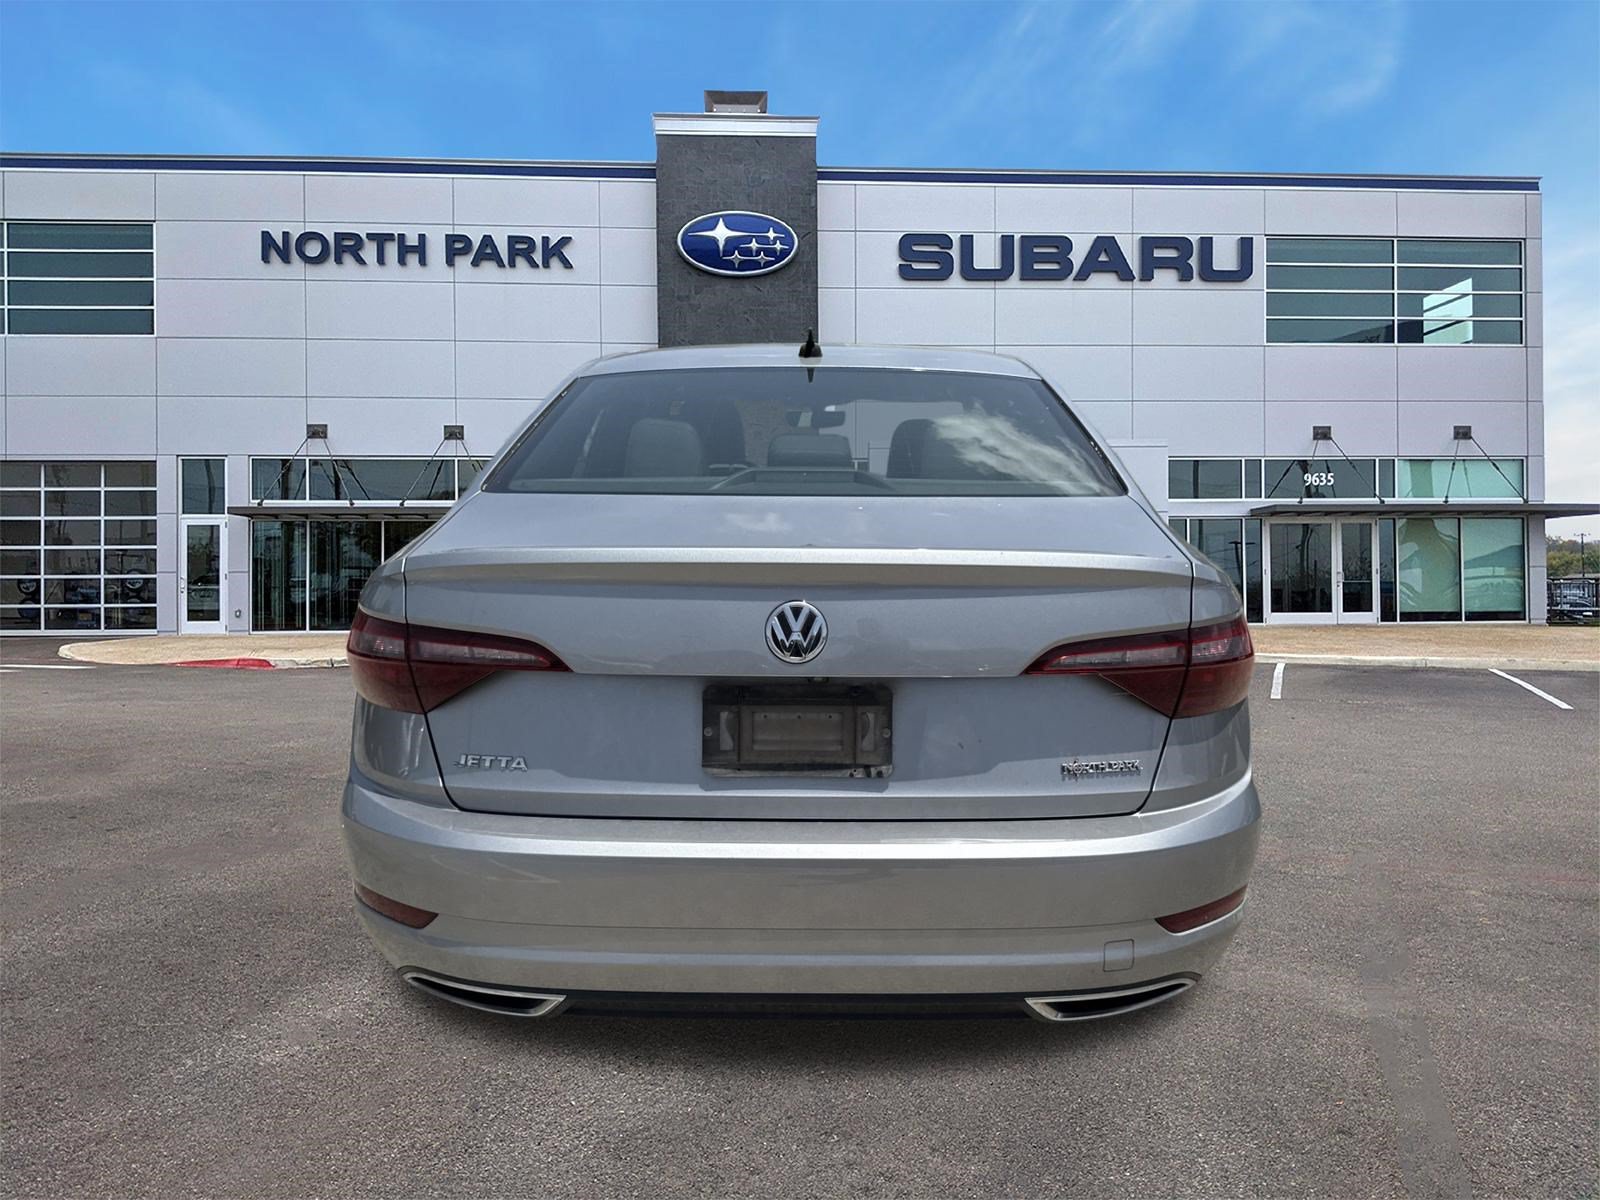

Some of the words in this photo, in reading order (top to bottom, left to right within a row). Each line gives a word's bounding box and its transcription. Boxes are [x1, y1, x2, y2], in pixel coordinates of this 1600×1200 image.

[260, 230, 427, 266] NORTH
[444, 234, 574, 269] PARK
[898, 233, 1254, 282] SUBARU
[1303, 472, 1335, 486] 9635
[453, 753, 528, 772] JETTA
